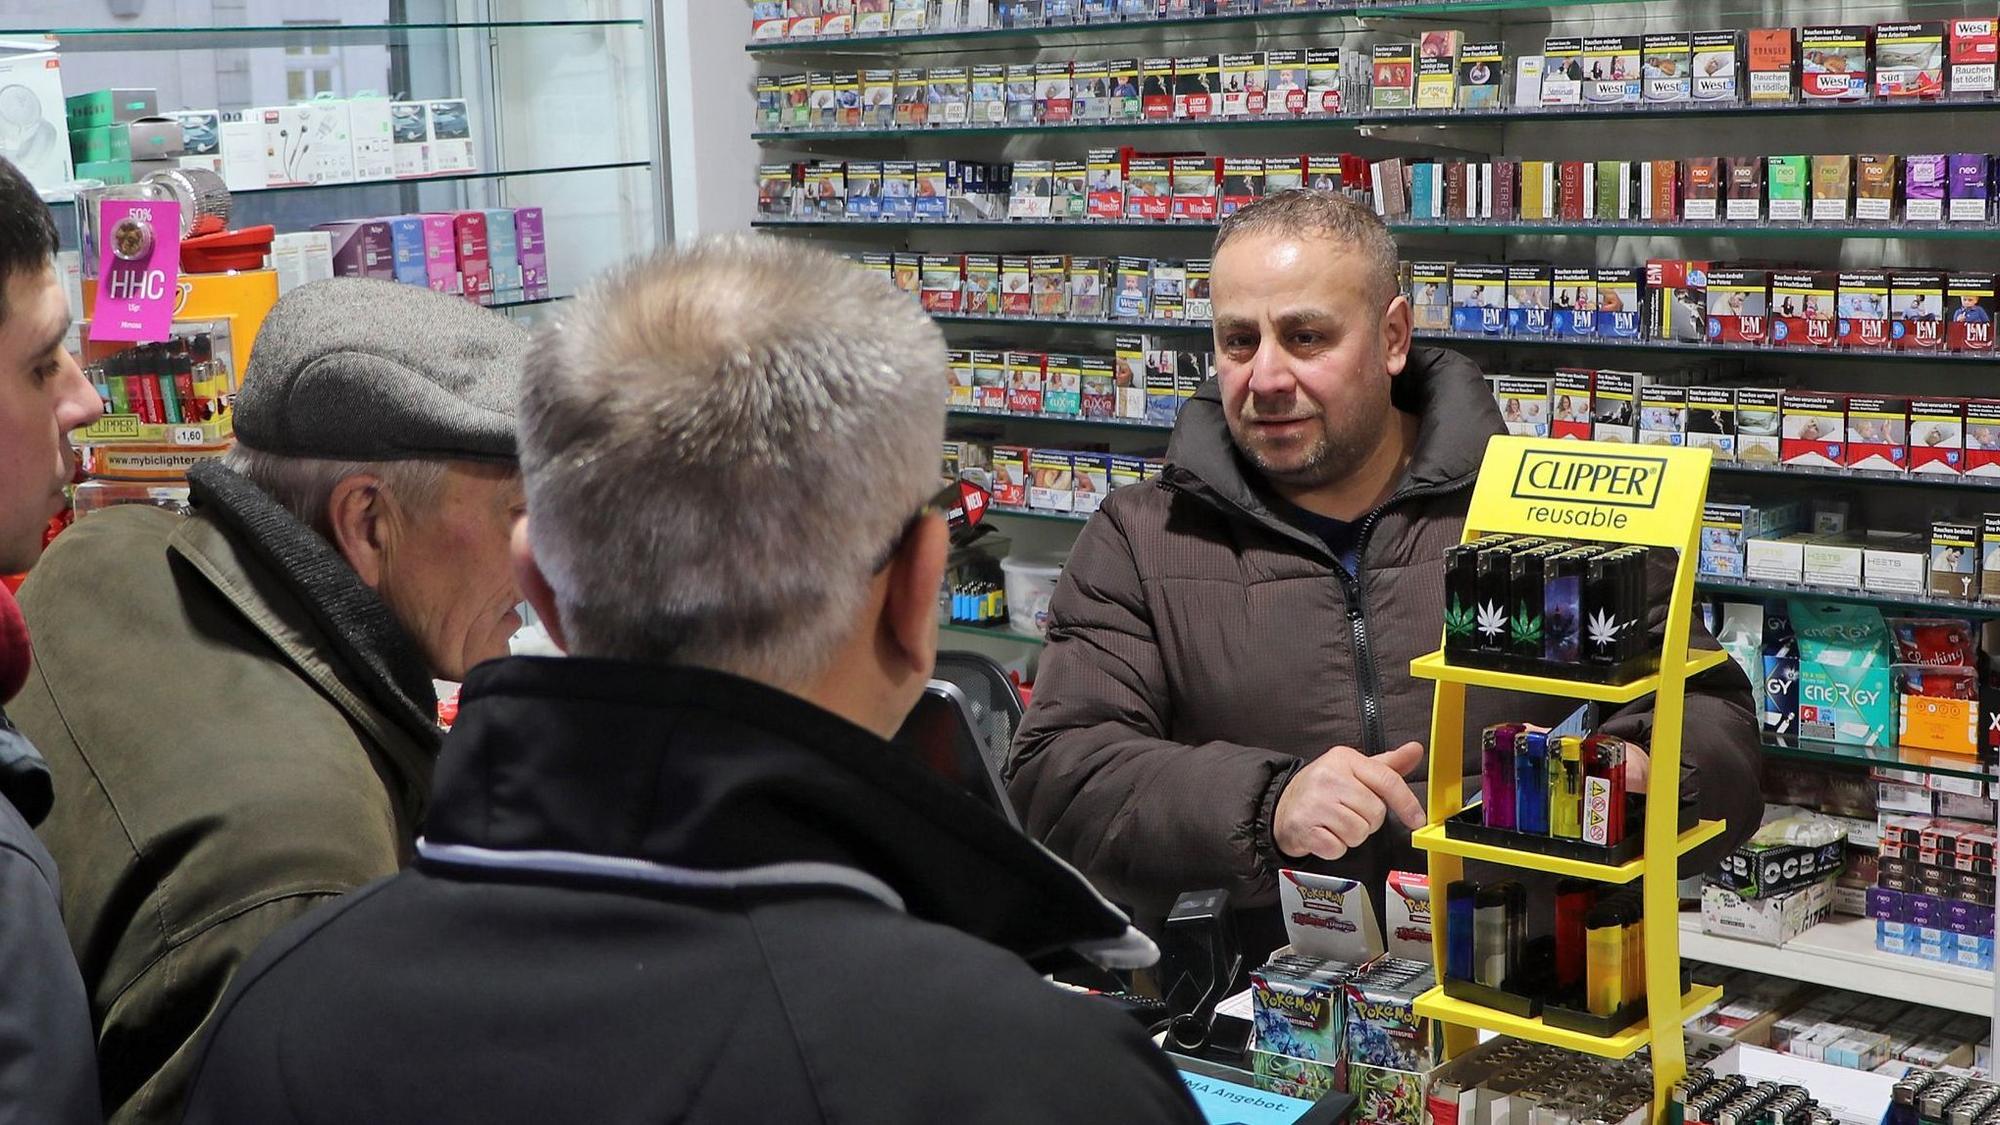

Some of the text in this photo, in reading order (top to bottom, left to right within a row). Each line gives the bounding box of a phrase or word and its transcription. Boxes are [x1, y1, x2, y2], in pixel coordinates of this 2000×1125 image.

[1958, 24, 1988, 33] West
[1881, 73, 1899, 81] Süd
[1956, 66, 1991, 75] Rauchen
[1754, 74, 1787, 82] Rauchen
[1819, 77, 1847, 88] West
[1965, 74, 1993, 83] tödlich
[1599, 84, 1623, 93] West
[1654, 83, 1679, 92] West
[1700, 81, 1723, 90] West
[1762, 82, 1788, 91] tödlich
[1661, 182, 1670, 215] TEREA
[129, 208, 152, 221] 50%
[110, 270, 165, 300] HHC
[1483, 309, 1500, 324] L&M
[1528, 310, 1544, 324] L&M
[1574, 311, 1591, 326] L&M
[1615, 312, 1632, 328] L&M
[1741, 318, 1760, 333] L&M
[1809, 321, 1827, 338] L&M
[1862, 321, 1882, 337] L&M
[1917, 322, 1936, 339] L&M
[1967, 323, 1986, 341] L&M
[182, 432, 200, 441] 1,60
[1529, 460, 1649, 496] CLIPPER
[1527, 506, 1628, 529] reusable
[1868, 558, 1901, 567] HEETS
[1720, 855, 1748, 877] CB
[1764, 852, 1815, 884] OCB
[1914, 901, 1928, 909] neo
[1952, 907, 1966, 915] neo
[1951, 922, 1965, 930] neo
[1183, 1078, 1289, 1112] MA Angebot:
